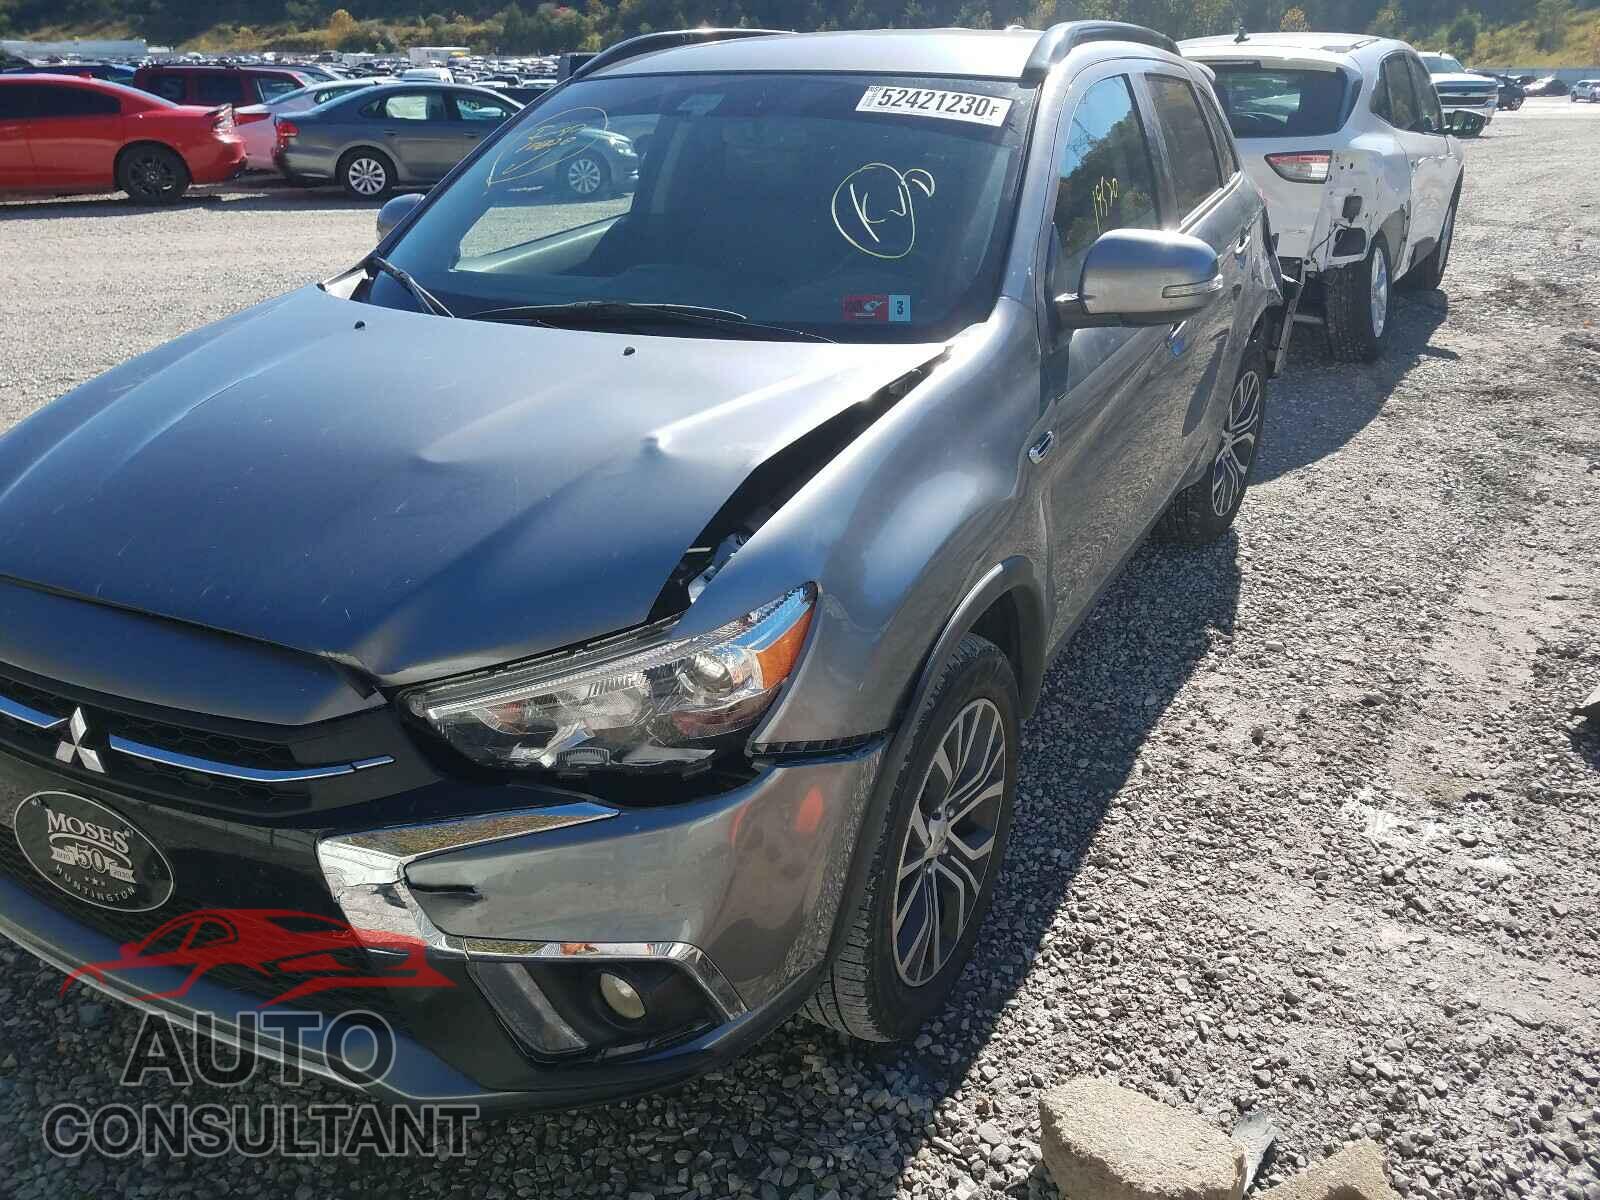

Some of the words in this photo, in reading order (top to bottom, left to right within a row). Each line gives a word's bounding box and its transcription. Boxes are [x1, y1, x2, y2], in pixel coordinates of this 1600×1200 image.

[896, 300, 904, 315] 3
[45, 808, 129, 854] MOSES
[75, 842, 107, 874] 50
[56, 864, 136, 902] HUNTINGTON
